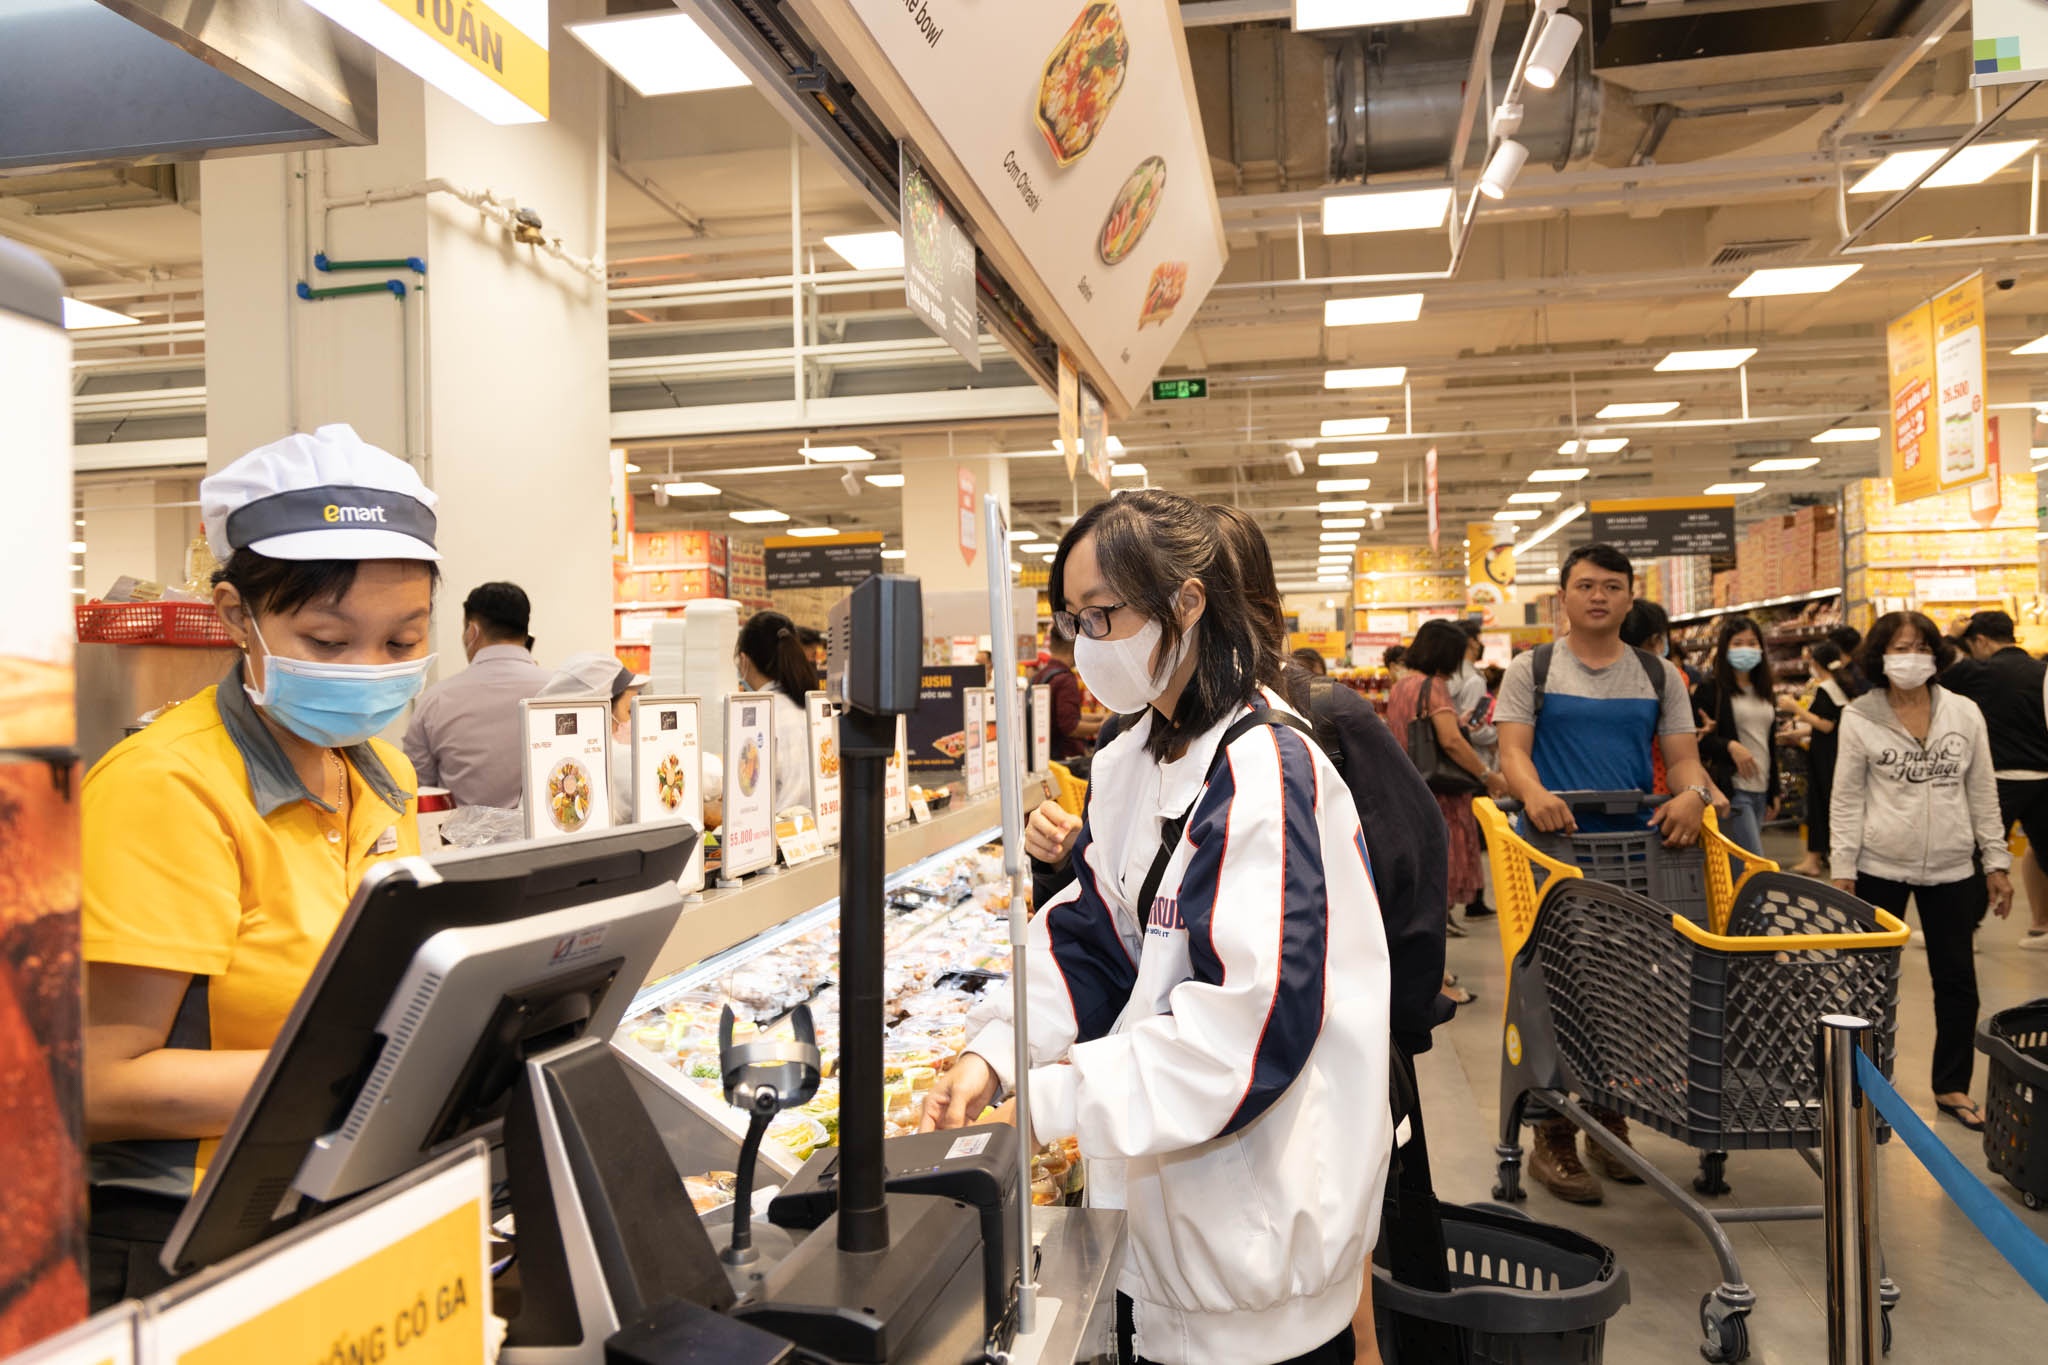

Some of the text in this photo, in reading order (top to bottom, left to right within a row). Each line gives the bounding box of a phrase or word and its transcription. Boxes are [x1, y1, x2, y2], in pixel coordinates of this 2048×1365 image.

[915, 1, 944, 48] bowl
[323, 504, 387, 523] emart
[729, 828, 753, 847] 55.000
[437, 1276, 467, 1321] GA
